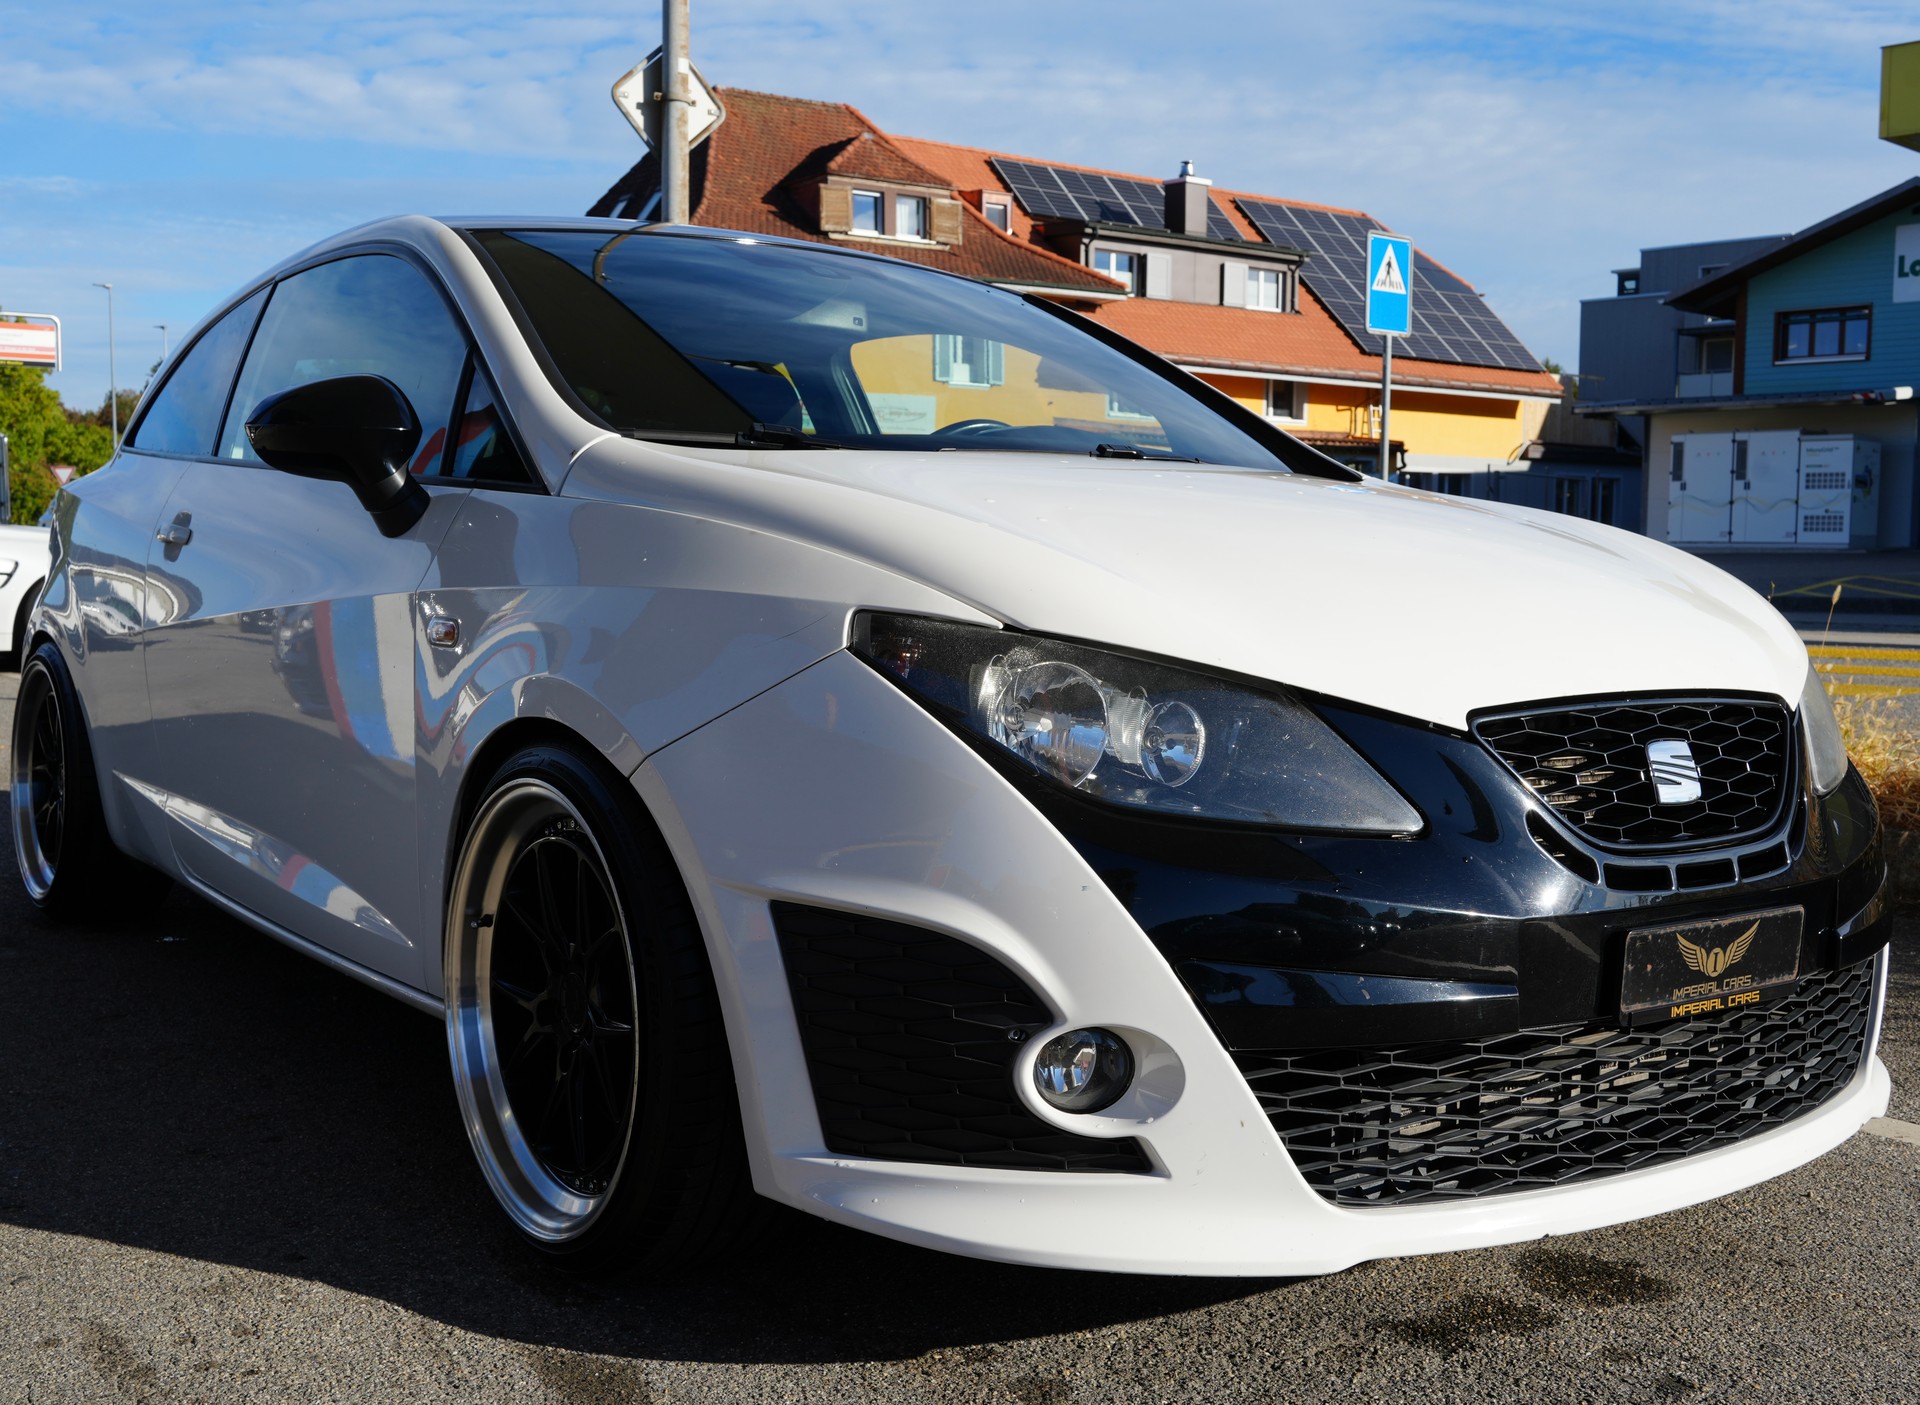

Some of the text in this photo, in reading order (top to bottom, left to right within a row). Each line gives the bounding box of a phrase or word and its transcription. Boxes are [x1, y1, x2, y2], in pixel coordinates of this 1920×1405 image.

[1672, 974, 1752, 1001] IMPERIAL CARS
[1671, 990, 1760, 1018] IMPERIAL CARS
